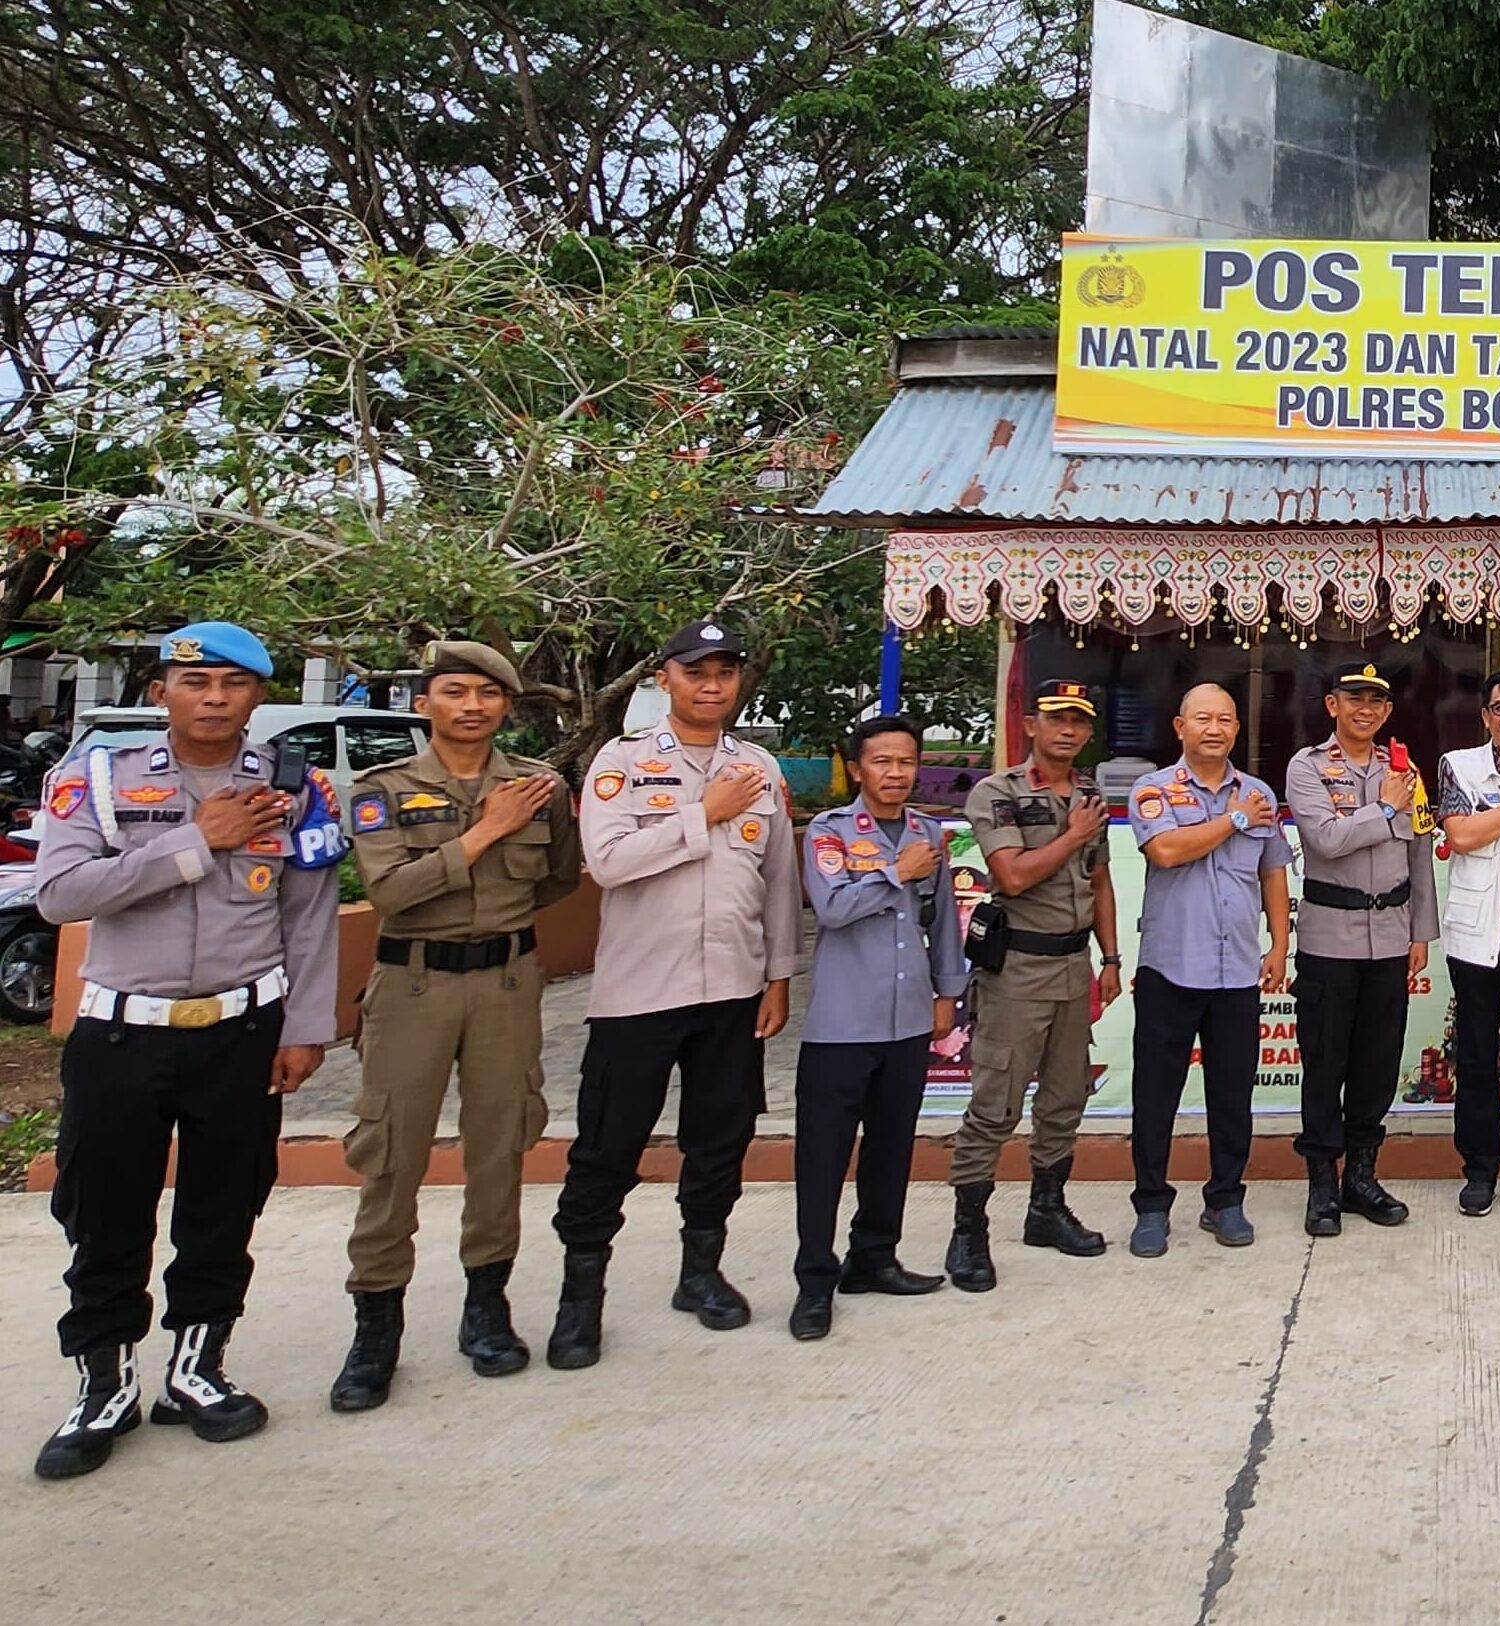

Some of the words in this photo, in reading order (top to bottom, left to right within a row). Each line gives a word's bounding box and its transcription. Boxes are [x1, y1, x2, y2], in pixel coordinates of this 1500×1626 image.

[1202, 251, 1360, 313] POS
[1080, 327, 1219, 369] NATAL
[1235, 331, 1347, 373] 2023
[1366, 333, 1455, 374] DAN
[1278, 386, 1445, 430] POLRES
[299, 822, 350, 864] PR
[1408, 977, 1431, 994] 23
[1260, 1002, 1297, 1015] EMB
[1261, 1047, 1300, 1065] BA
[1254, 1073, 1300, 1086] UARI
